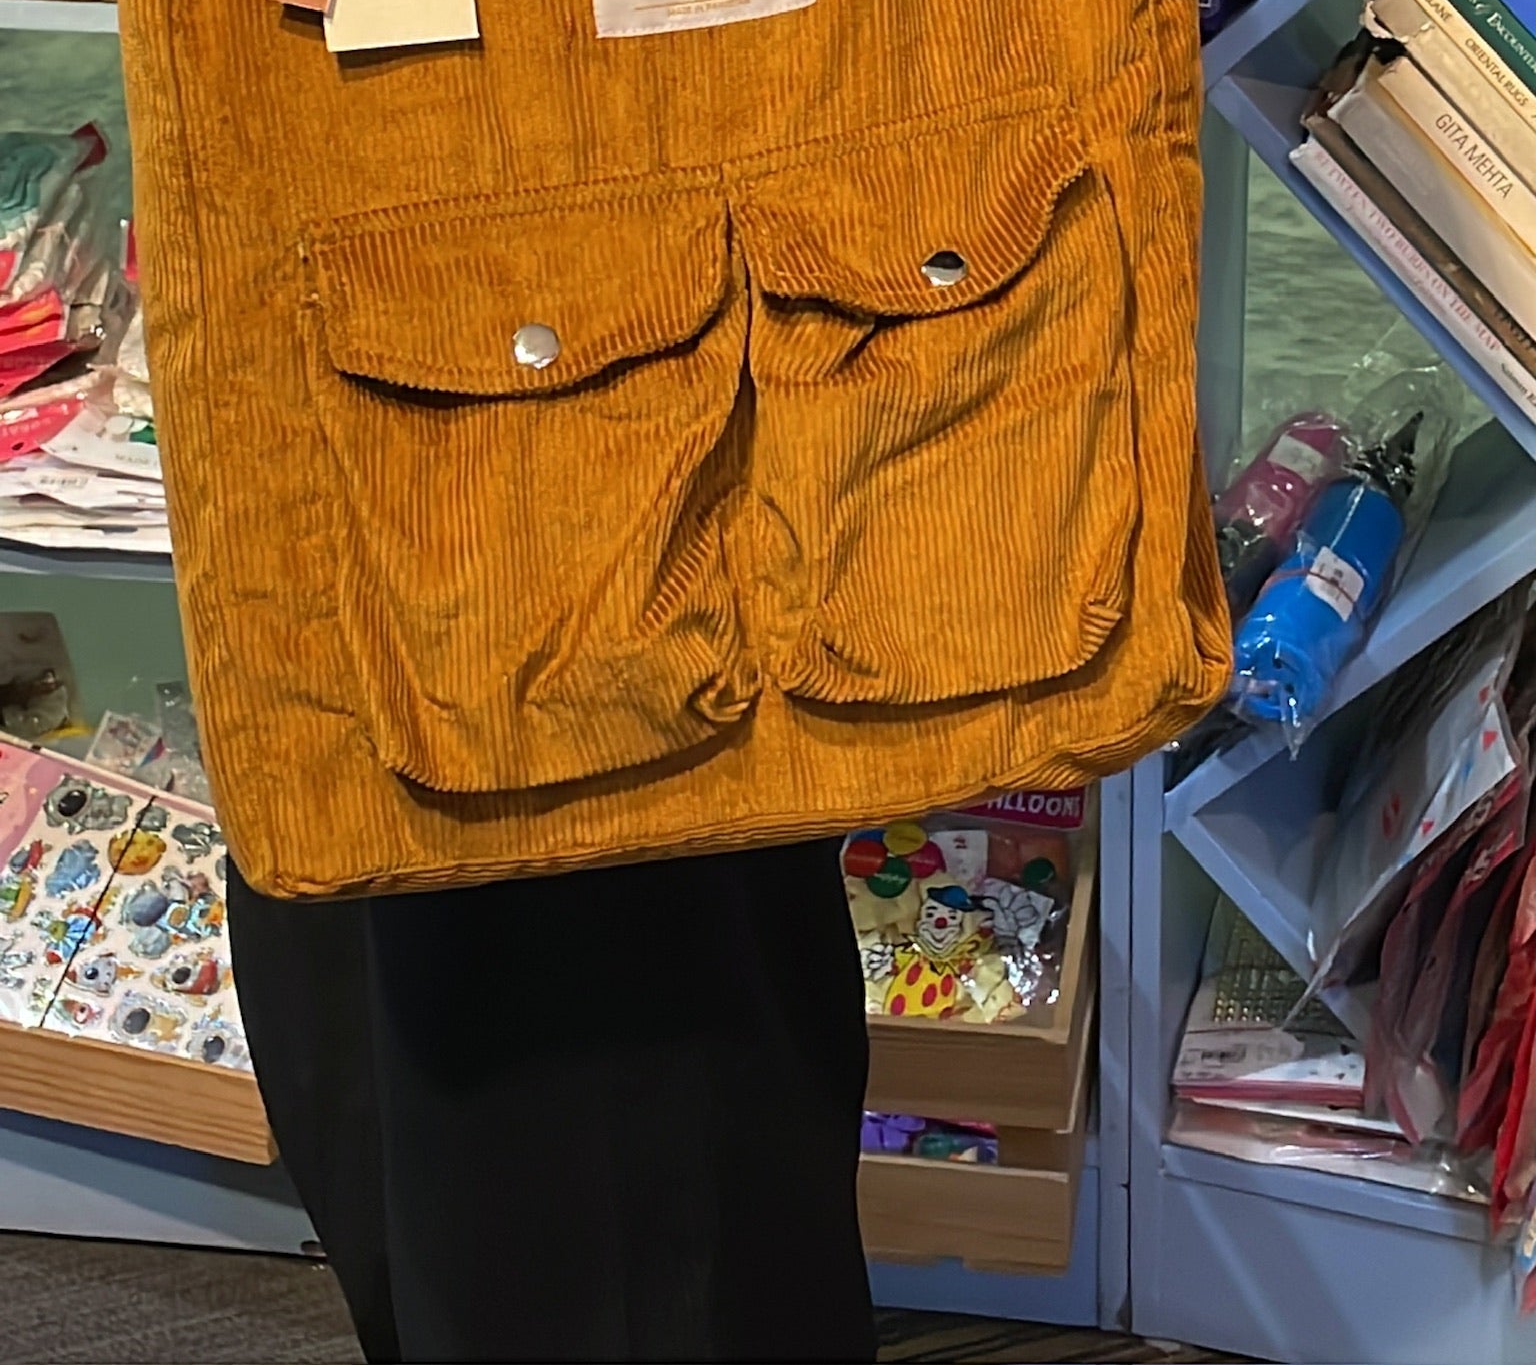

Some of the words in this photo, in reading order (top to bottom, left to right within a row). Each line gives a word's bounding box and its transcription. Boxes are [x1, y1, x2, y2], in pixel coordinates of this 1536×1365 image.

[1464, 38, 1508, 85] ORIENTAL
[1502, 78, 1529, 107] RUGS
[1435, 113, 1469, 151] GITA
[1464, 144, 1515, 200] MEHTA
[1314, 150, 1367, 210] BETWEEN
[1367, 209, 1397, 239] TWO
[1448, 297, 1472, 322] THE
